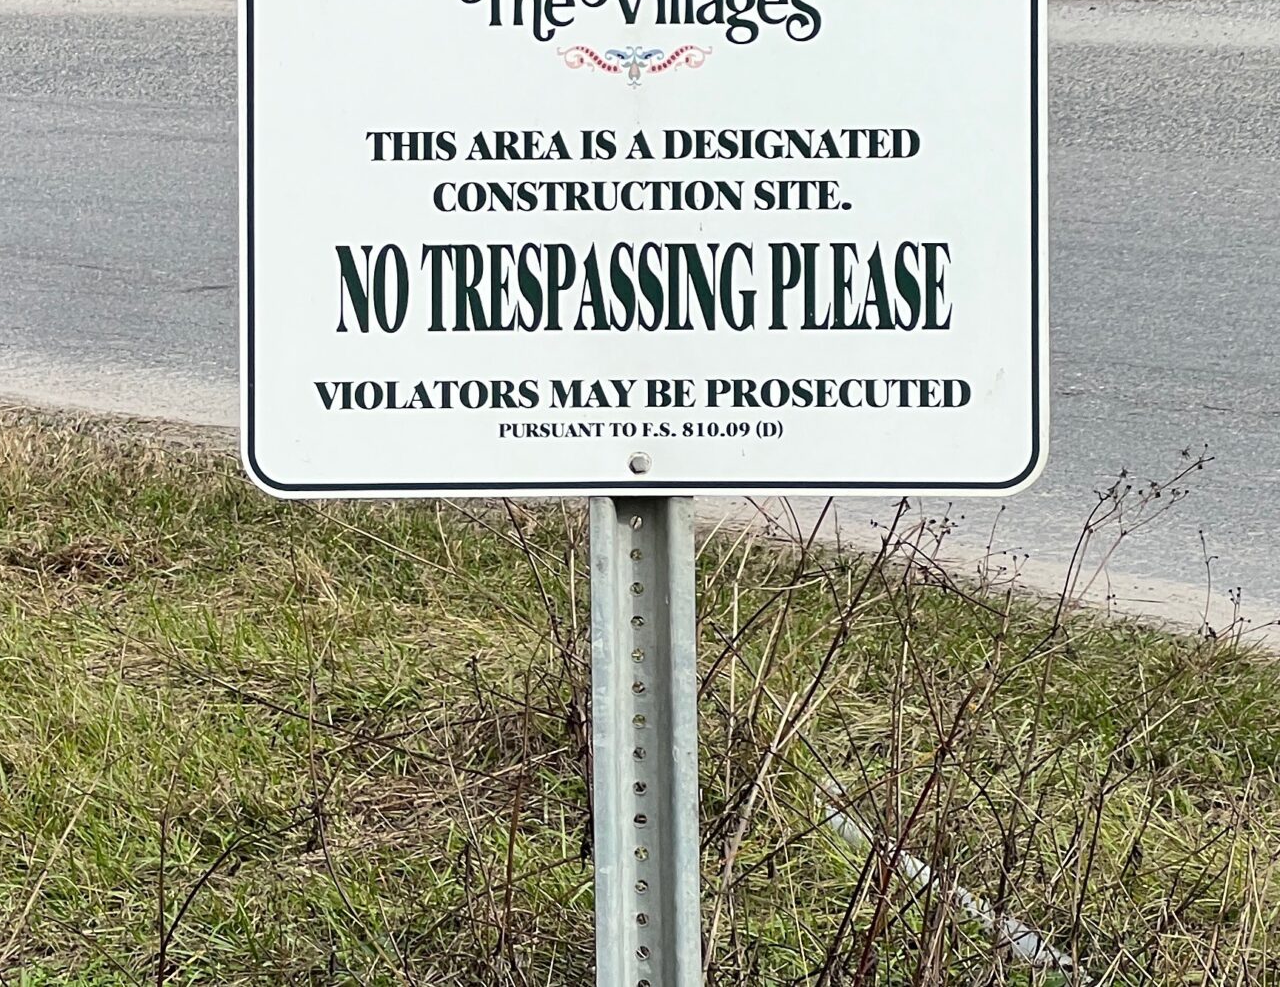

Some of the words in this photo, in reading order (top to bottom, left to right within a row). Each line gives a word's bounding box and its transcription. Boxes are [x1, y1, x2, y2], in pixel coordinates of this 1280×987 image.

[365, 130, 457, 162] THIS
[464, 130, 573, 161] AREA
[580, 129, 617, 161] IS
[625, 129, 655, 160] A
[662, 128, 921, 160] DESIGNATED
[433, 180, 745, 213] CONSTRUCTION
[754, 179, 852, 211] SITE.
[335, 245, 410, 334] NO
[420, 241, 758, 333] TRESPASSING
[767, 240, 953, 332] PLEASE
[313, 379, 540, 411] VIOLATORS
[549, 379, 638, 410] MAY
[644, 379, 697, 409] BE
[705, 378, 971, 409] PROSECUTED
[498, 422, 605, 439] PURSUANT
[608, 422, 637, 438] TO
[641, 422, 677, 438] F.S.
[682, 422, 751, 438] 810.09
[755, 420, 784, 439] (D)
